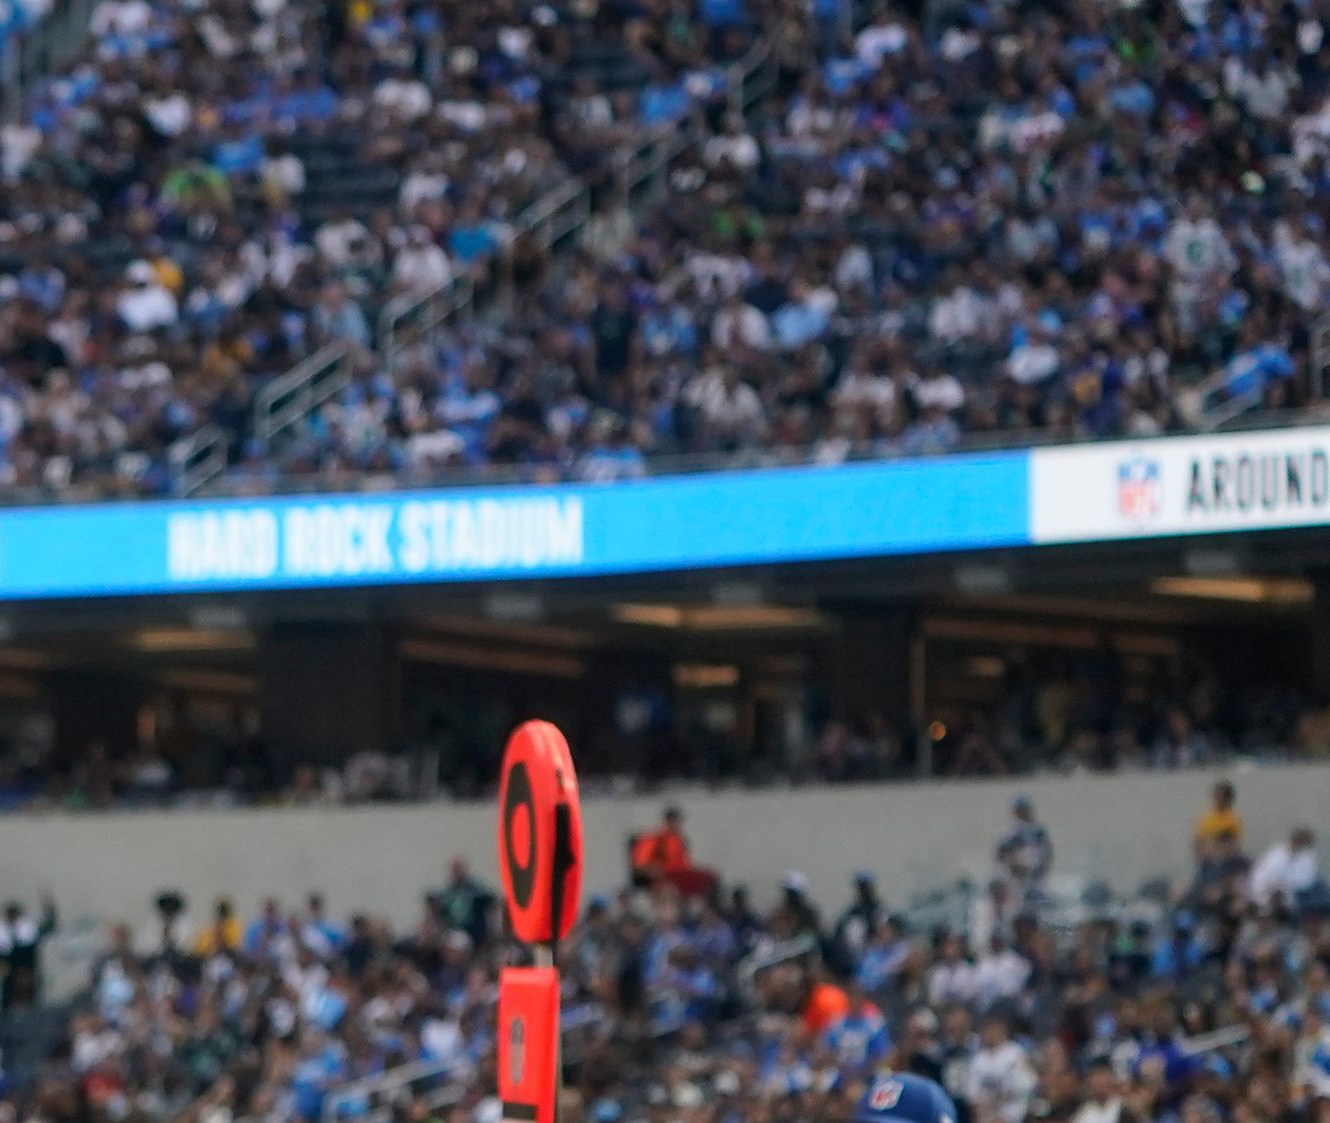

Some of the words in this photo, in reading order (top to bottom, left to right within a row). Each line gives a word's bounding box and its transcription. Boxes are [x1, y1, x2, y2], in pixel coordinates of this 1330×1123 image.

[1187, 449, 1330, 514] AROUND
[167, 510, 278, 581] HARD
[283, 505, 395, 576] ROCK
[398, 497, 584, 571] STADIUM
